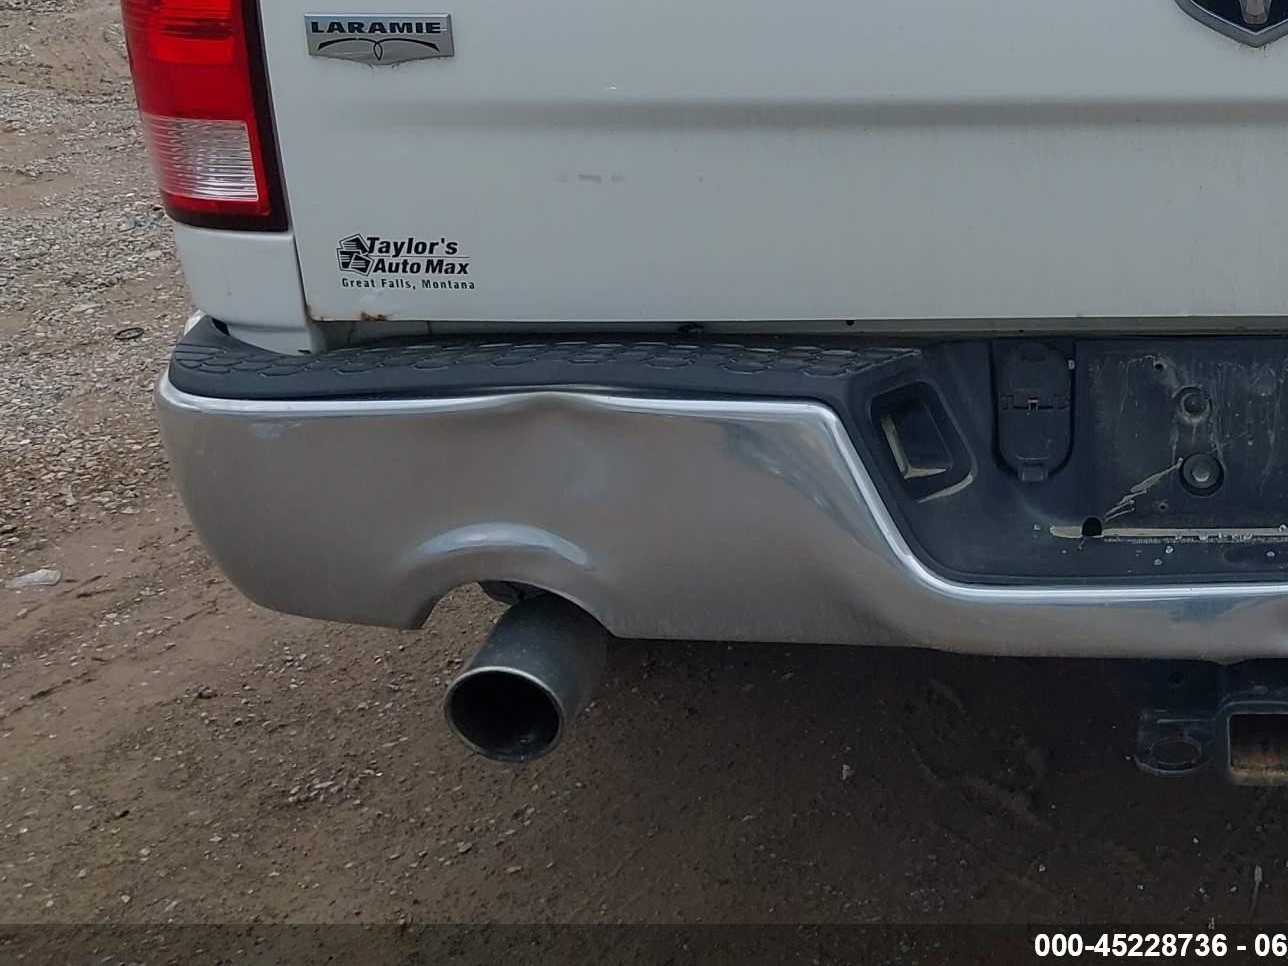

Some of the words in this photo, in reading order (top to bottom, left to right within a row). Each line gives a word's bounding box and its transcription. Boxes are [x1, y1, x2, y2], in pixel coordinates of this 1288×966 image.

[311, 21, 441, 34] LARAMIE
[366, 236, 458, 258] Taylor's
[372, 258, 421, 274] Auto
[425, 259, 470, 275] Max
[341, 277, 376, 288] Great
[381, 278, 416, 291] Falls,
[421, 279, 475, 290] Montana
